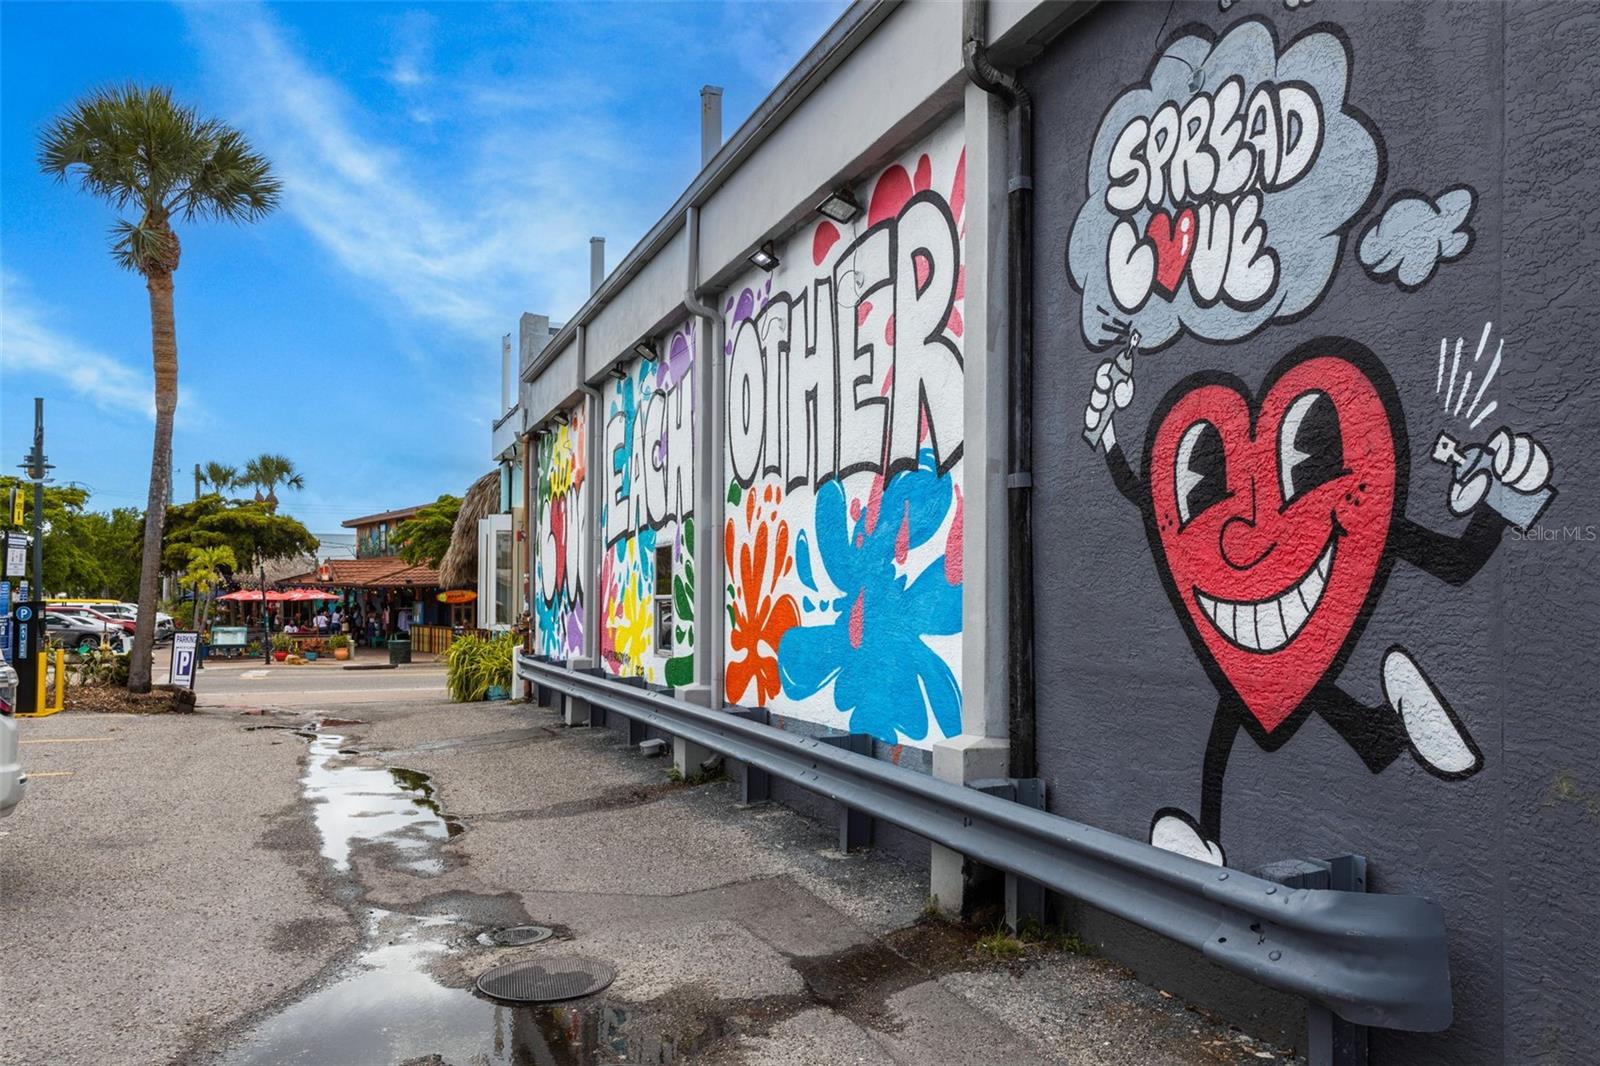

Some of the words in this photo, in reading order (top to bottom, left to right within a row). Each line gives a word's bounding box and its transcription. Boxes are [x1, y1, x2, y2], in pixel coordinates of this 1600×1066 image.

[1105, 74, 1324, 216] SPREAD
[1106, 192, 1281, 314] LOVE
[728, 189, 965, 498] OTHER
[606, 360, 695, 552] EACH
